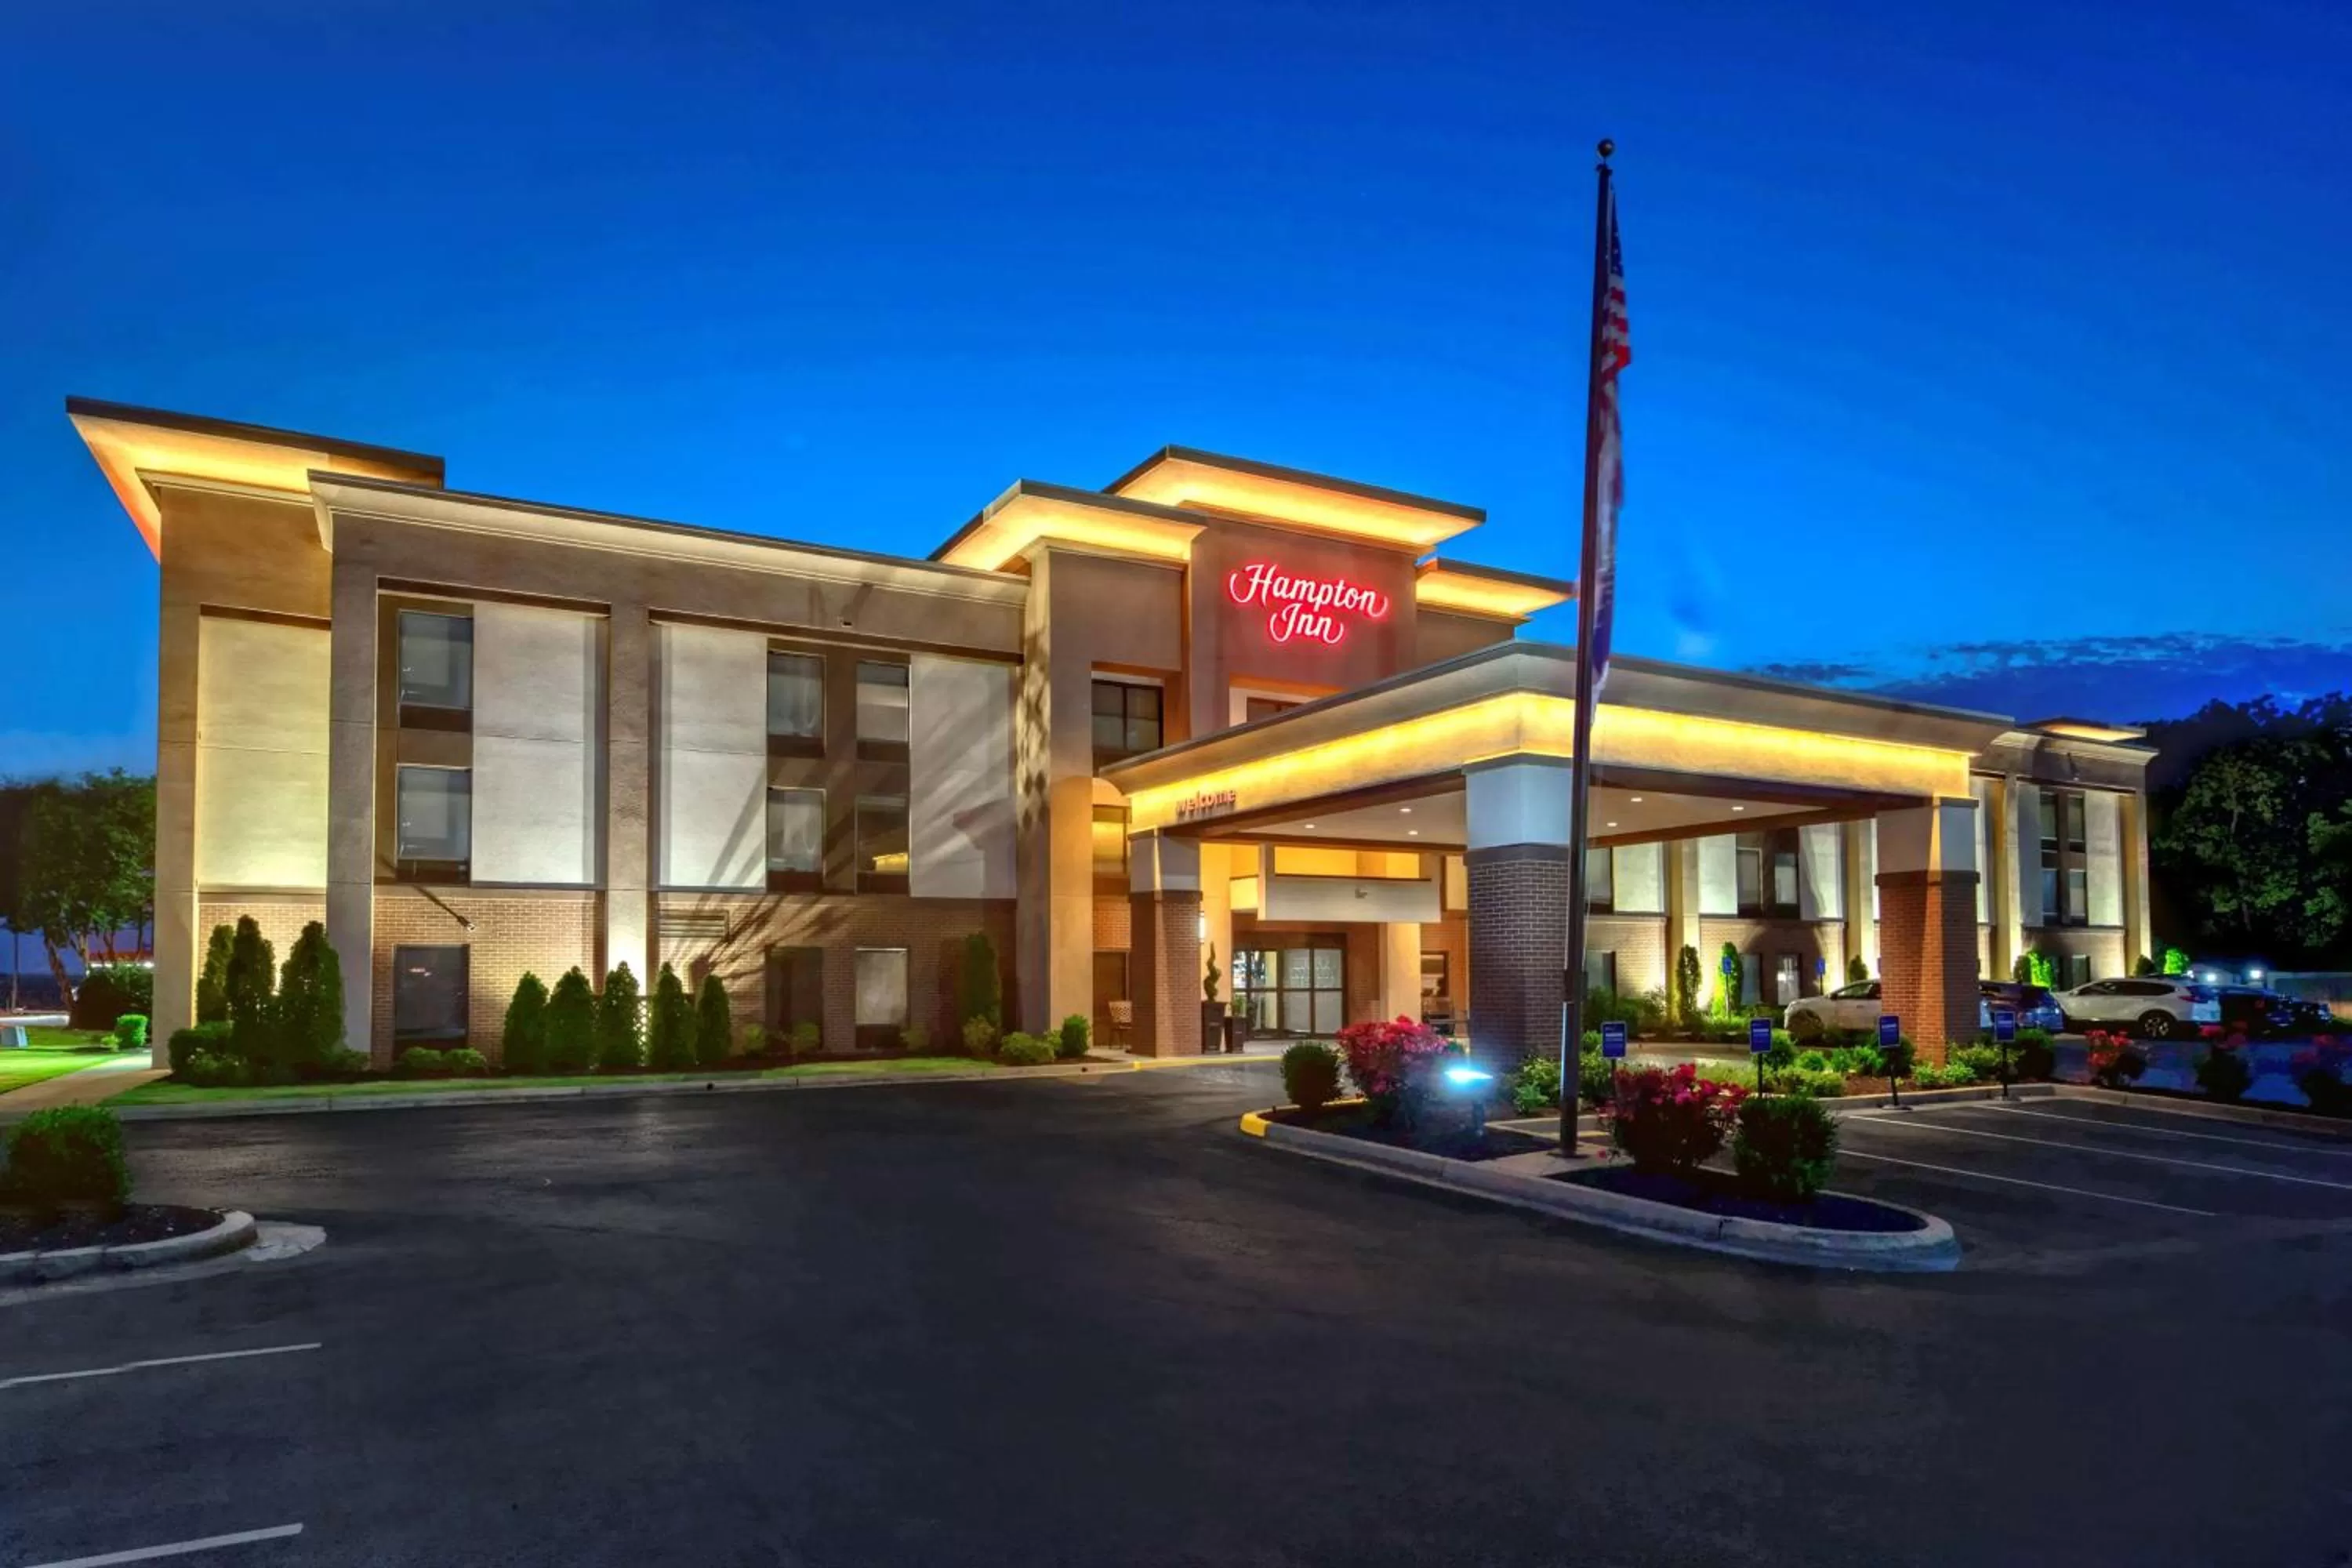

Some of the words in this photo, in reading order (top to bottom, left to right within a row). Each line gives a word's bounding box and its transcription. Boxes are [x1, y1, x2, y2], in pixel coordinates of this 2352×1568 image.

[1229, 564, 1388, 618] Hampton
[1269, 603, 1345, 644] Inn
[1176, 789, 1236, 813] welcome
